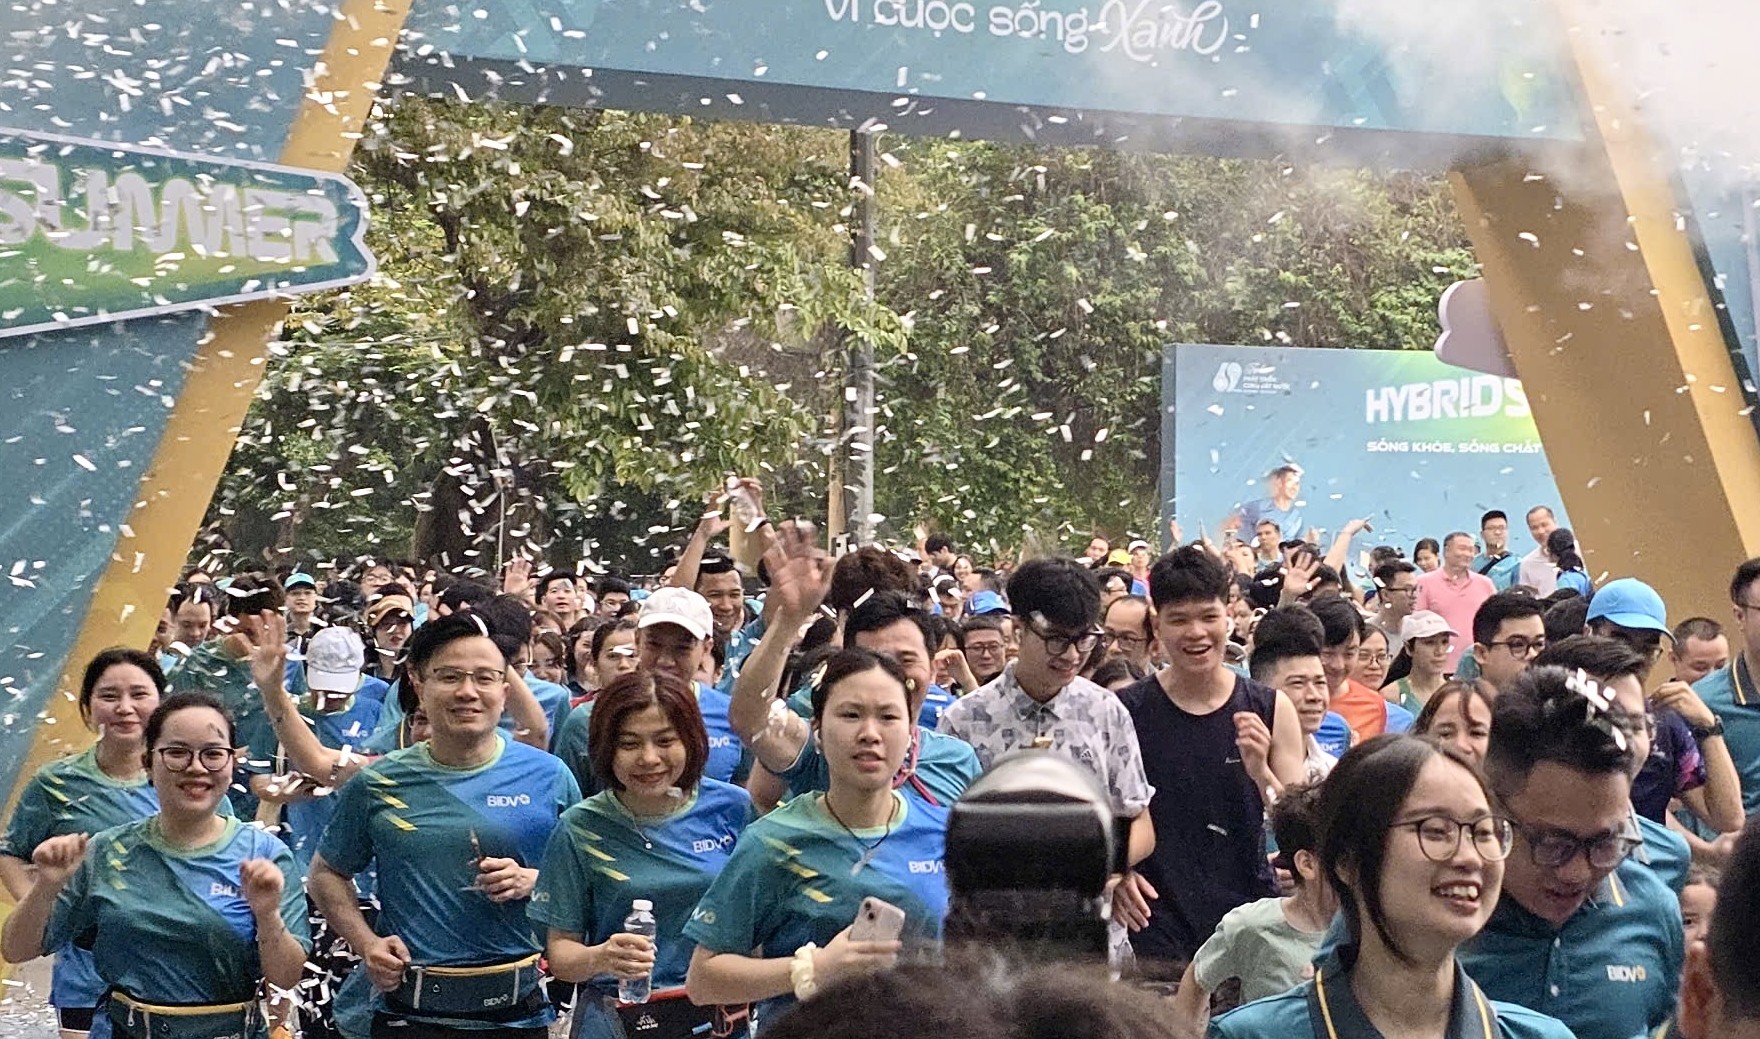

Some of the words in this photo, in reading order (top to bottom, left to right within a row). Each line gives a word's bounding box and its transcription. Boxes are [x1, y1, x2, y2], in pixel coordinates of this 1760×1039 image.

[486, 795, 519, 808] BIDV
[692, 837, 724, 853] BIDV
[908, 859, 941, 874] BIDV
[1605, 964, 1637, 983] BIDV
